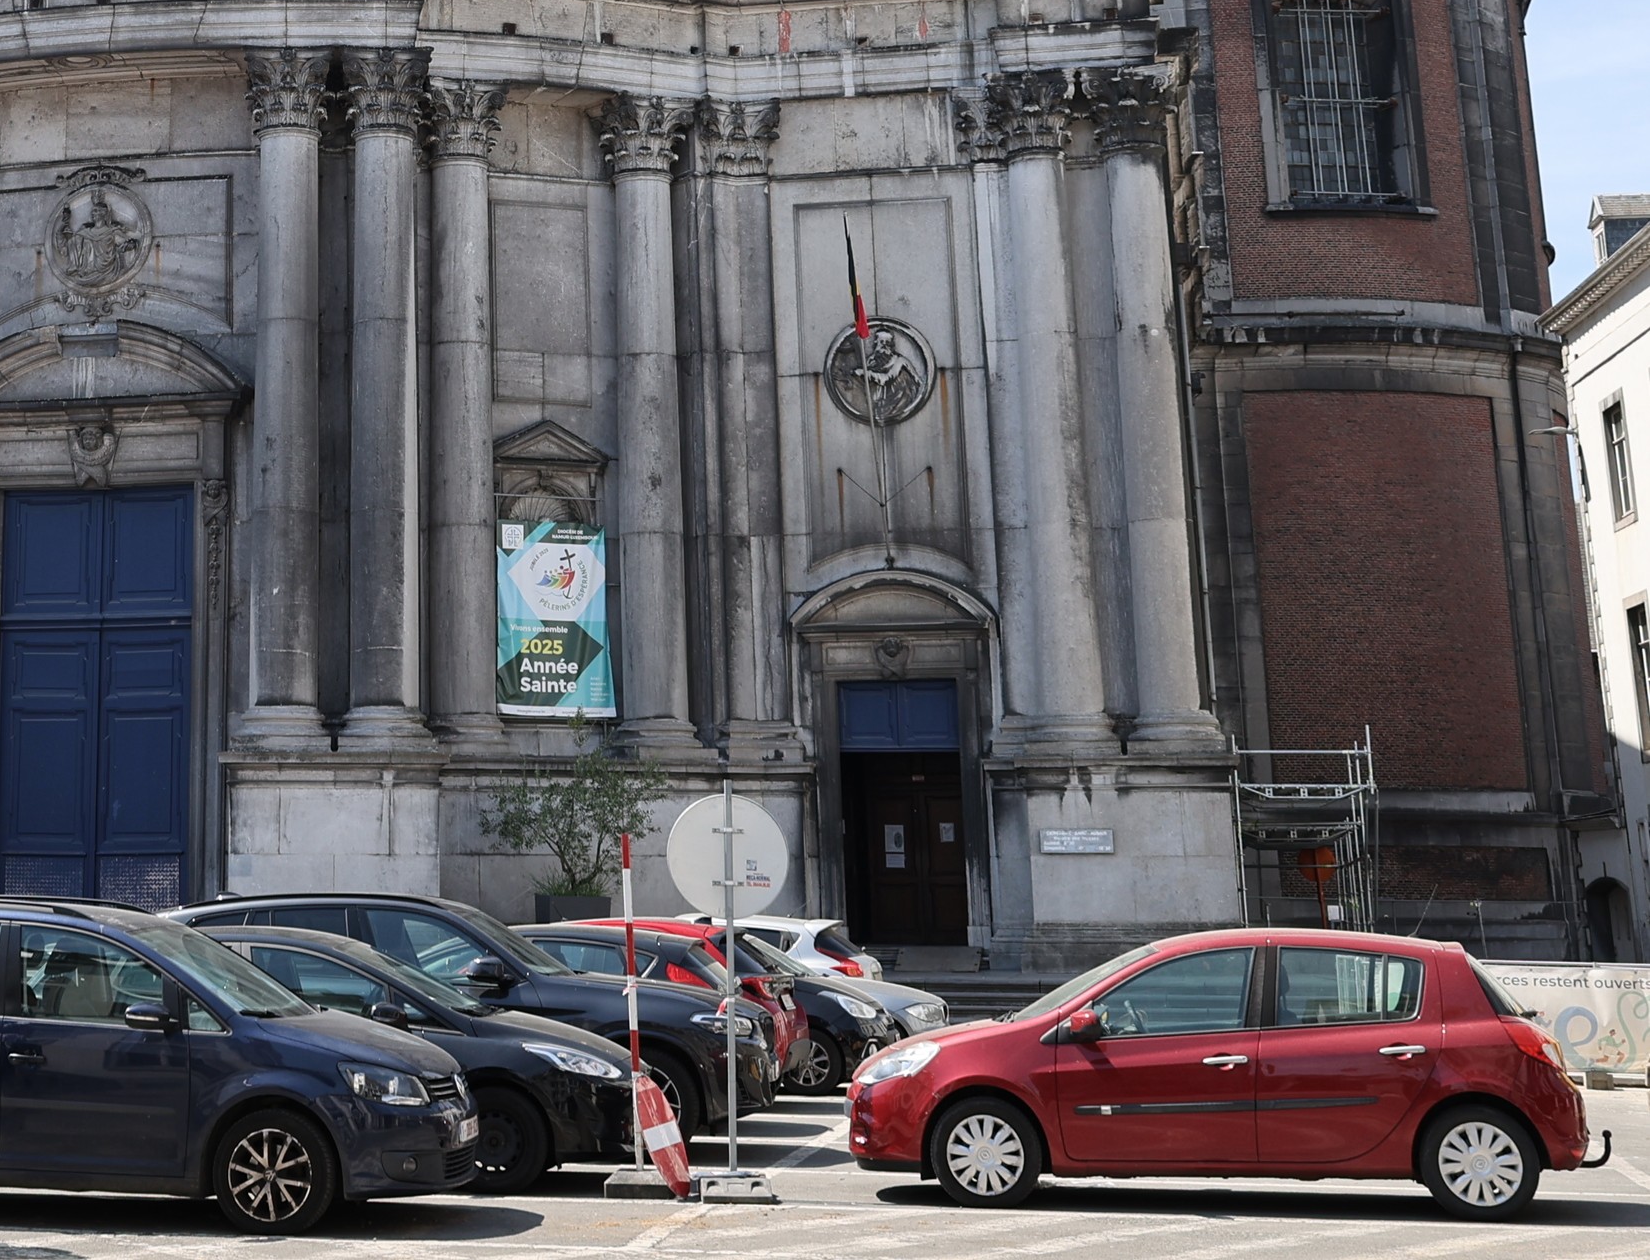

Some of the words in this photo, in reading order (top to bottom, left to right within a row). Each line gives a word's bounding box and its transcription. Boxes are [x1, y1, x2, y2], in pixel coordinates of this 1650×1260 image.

[539, 597, 571, 612] PÈLERINS
[510, 624, 532, 632] Vivons
[532, 625, 569, 634] ensemble
[520, 638, 564, 655] 2025
[519, 657, 579, 674] Année
[520, 676, 578, 693] Sainte
[1533, 977, 1590, 988] restent
[1594, 979, 1650, 990] ouverts
